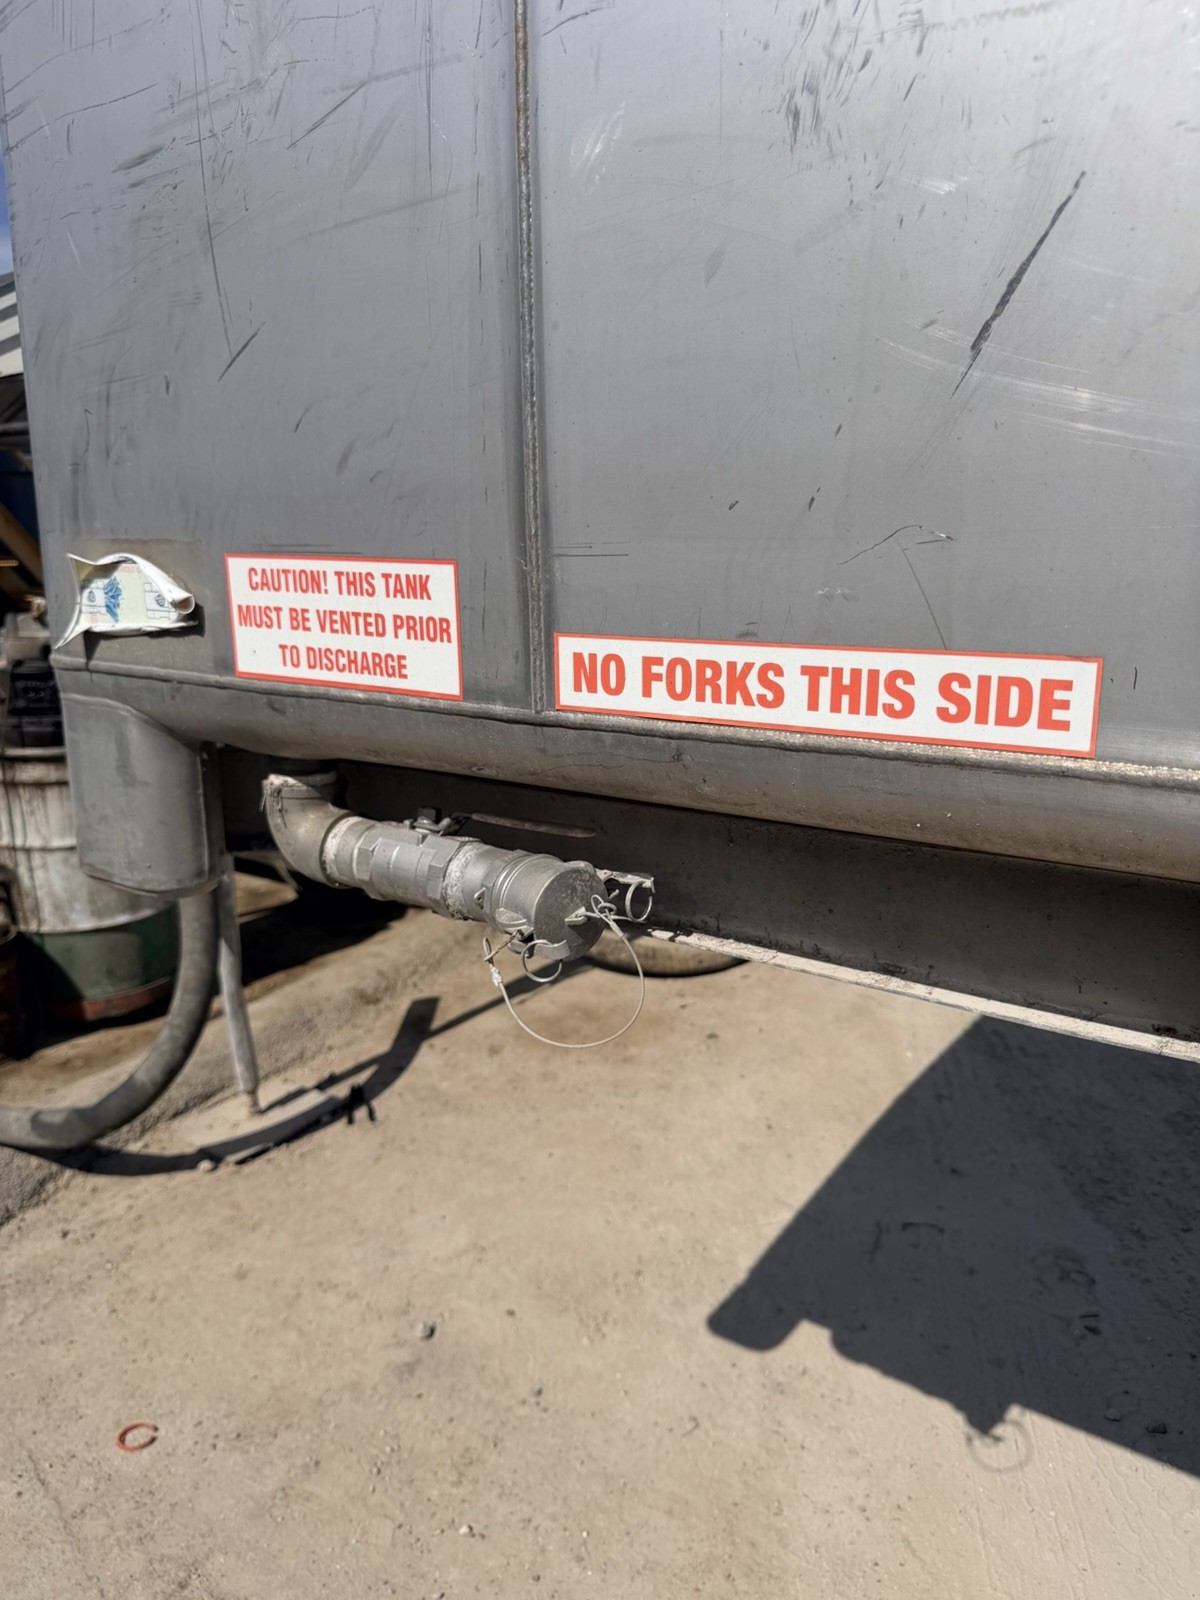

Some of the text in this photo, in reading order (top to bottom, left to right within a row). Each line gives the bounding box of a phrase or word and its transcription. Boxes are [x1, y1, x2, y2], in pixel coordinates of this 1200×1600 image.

[248, 567, 432, 600] CAUTION! THIS TANK
[237, 604, 452, 643] MUST BE VENTED PRIOR
[279, 644, 408, 679] TO DISCHARGE
[572, 651, 1073, 732] NO FORKS THIS SIDE
